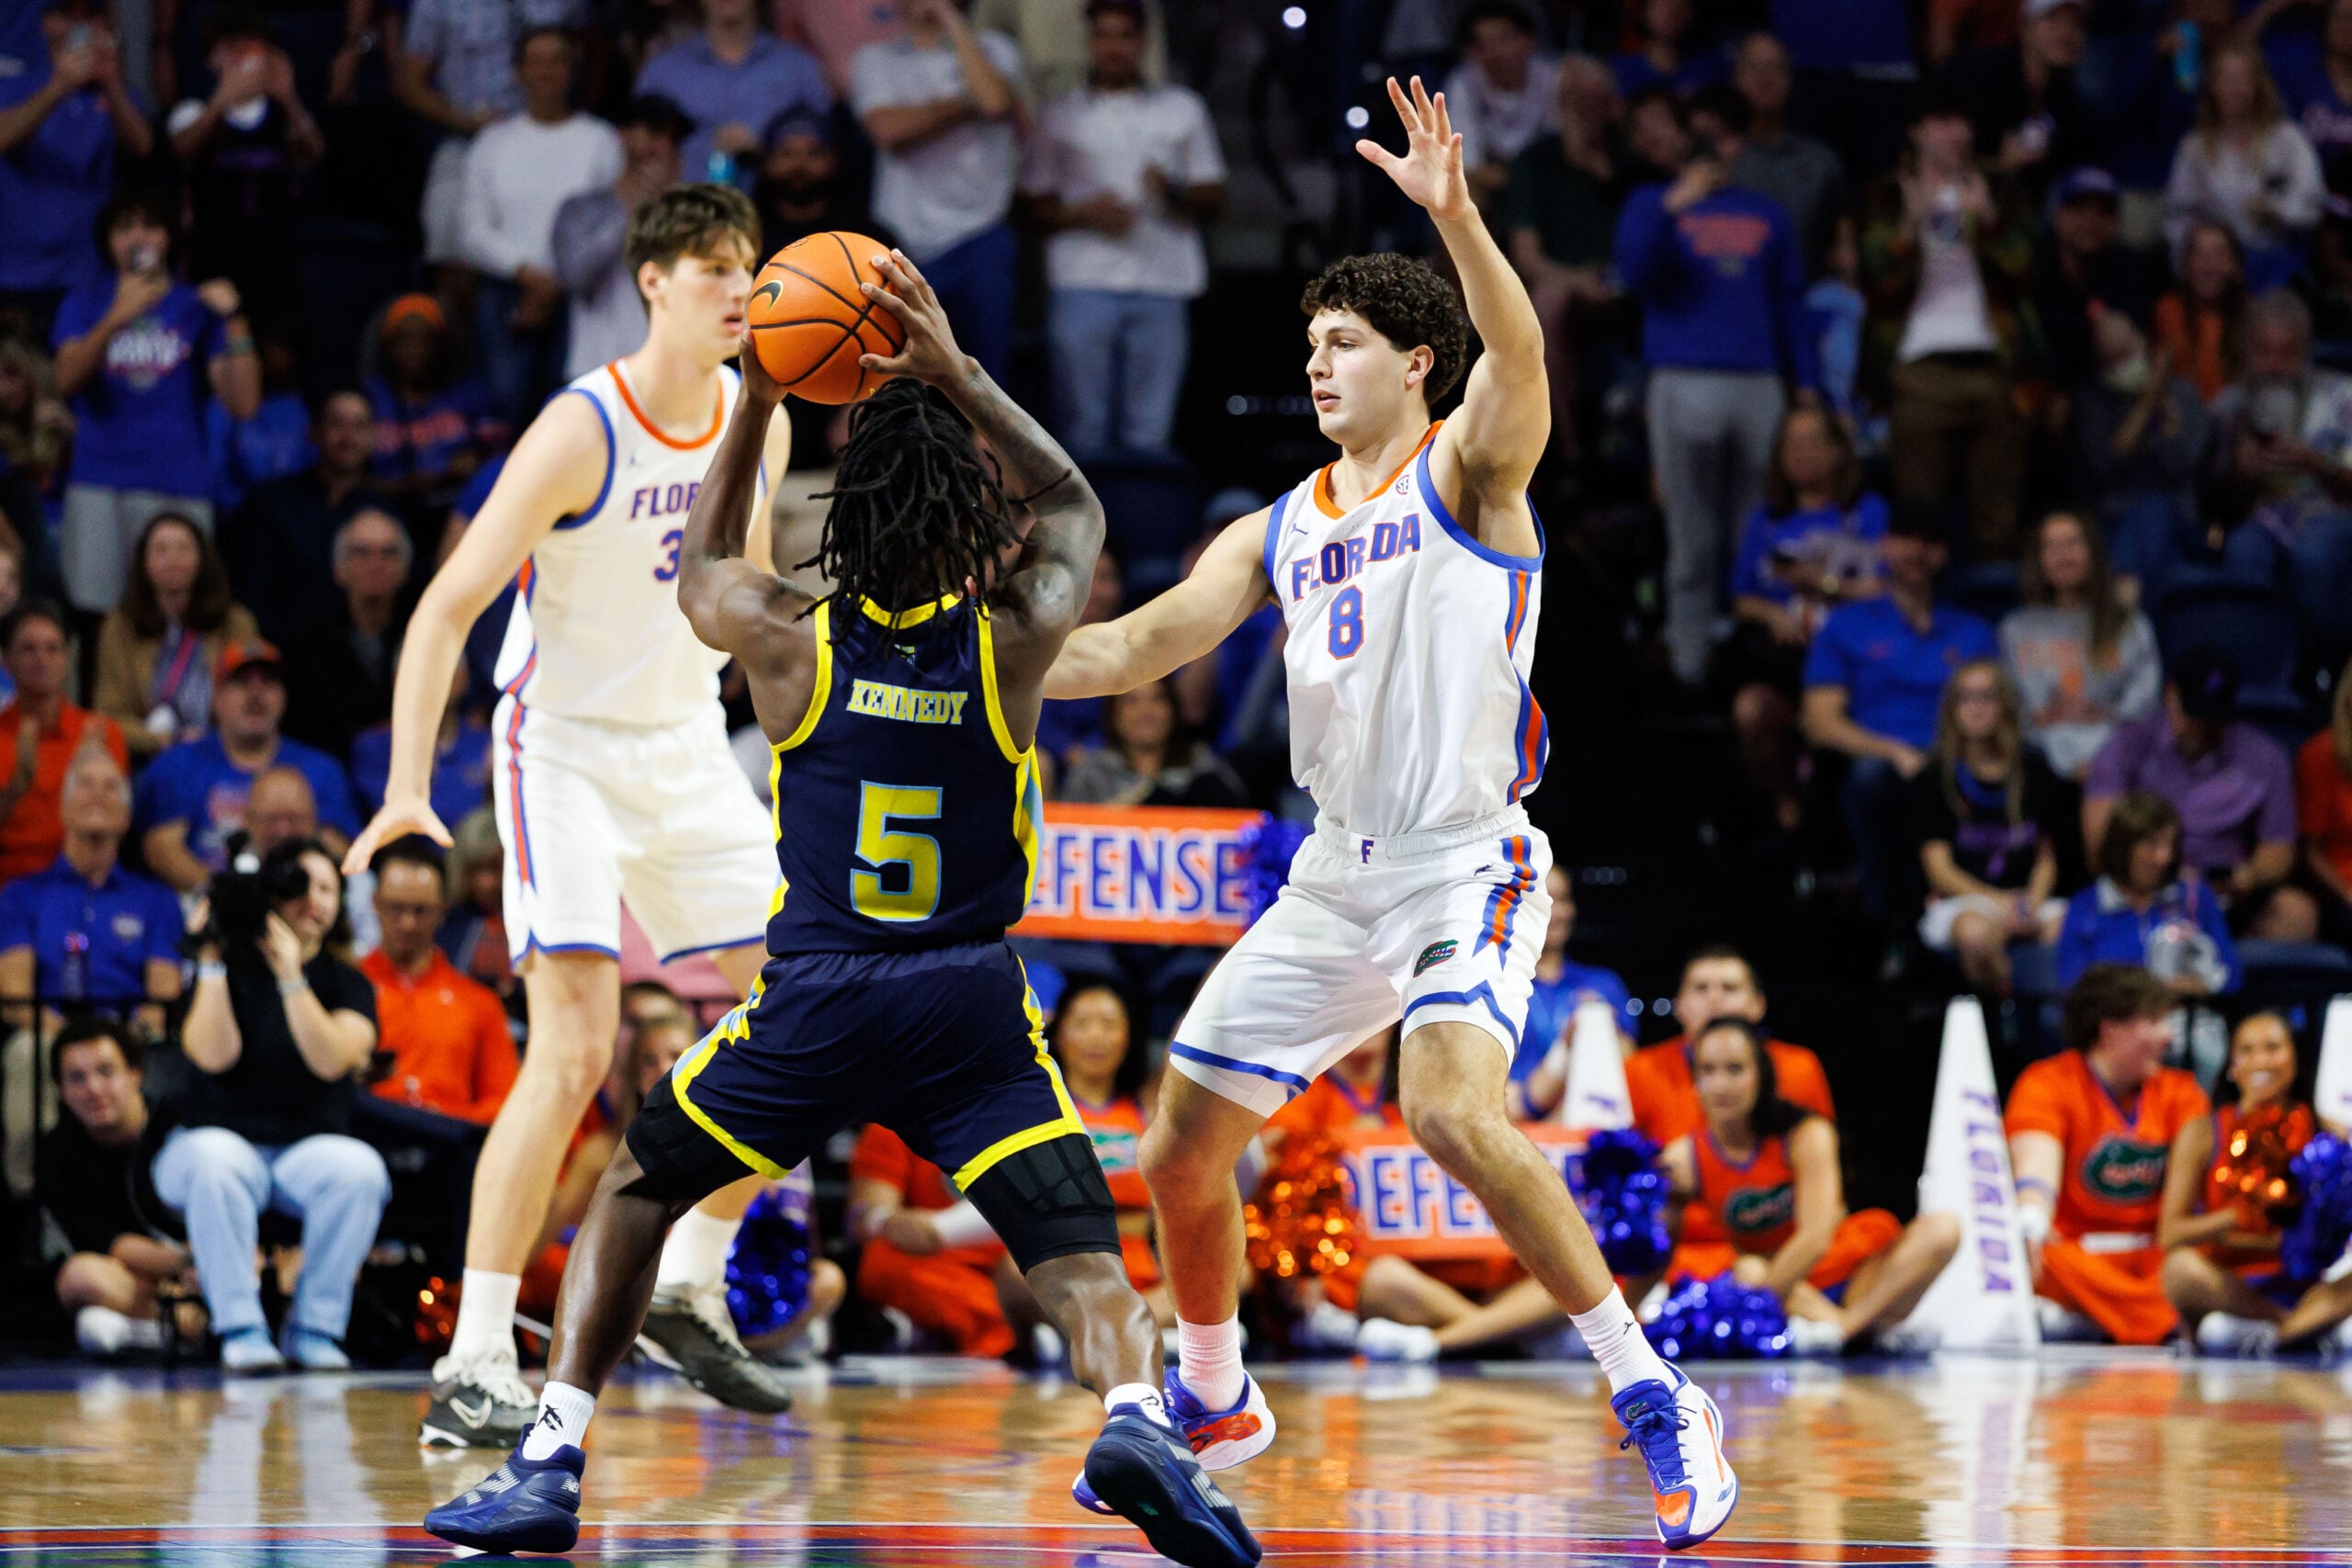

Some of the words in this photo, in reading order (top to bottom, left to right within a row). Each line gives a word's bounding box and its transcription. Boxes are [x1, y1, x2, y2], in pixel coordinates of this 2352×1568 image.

[653, 528, 684, 581] 3
[1290, 512, 1421, 603] FLORDA
[1328, 583, 1364, 660] 8
[846, 678, 968, 725] KENNEDY
[850, 780, 944, 922] 5
[1030, 835, 1242, 913] FENSE
[1361, 839, 1374, 864] F
